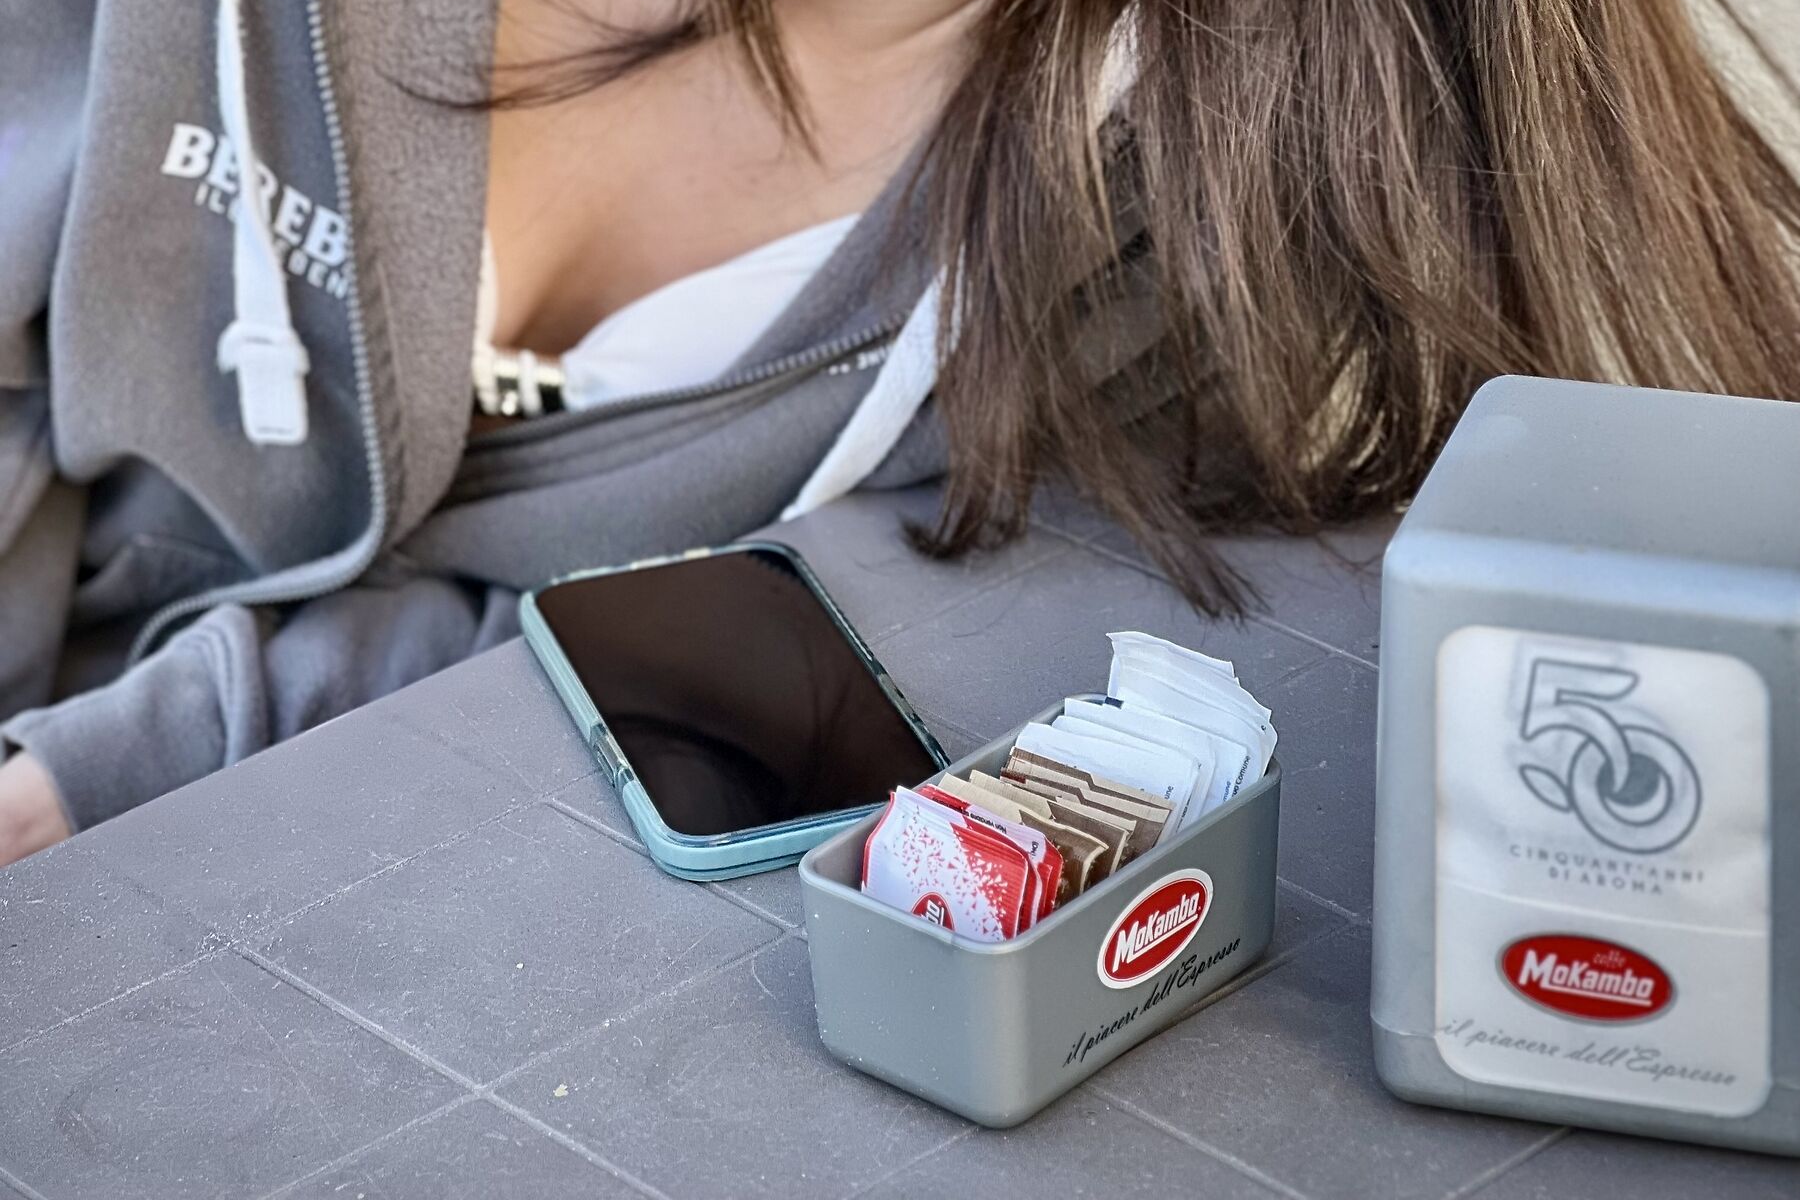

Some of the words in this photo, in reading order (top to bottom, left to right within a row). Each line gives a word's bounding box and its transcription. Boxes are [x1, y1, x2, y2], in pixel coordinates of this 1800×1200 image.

[1518, 658, 1702, 856] 50
[1509, 844, 1704, 882] CINQUANT'ANNI
[1062, 1032, 1087, 1069] il
[1080, 1006, 1139, 1064] piacere
[1139, 937, 1242, 1016] dell'Espresso
[1438, 1018, 1475, 1037] il
[1464, 1030, 1561, 1057] piacere
[1563, 1042, 1737, 1088] dell'Espresso
